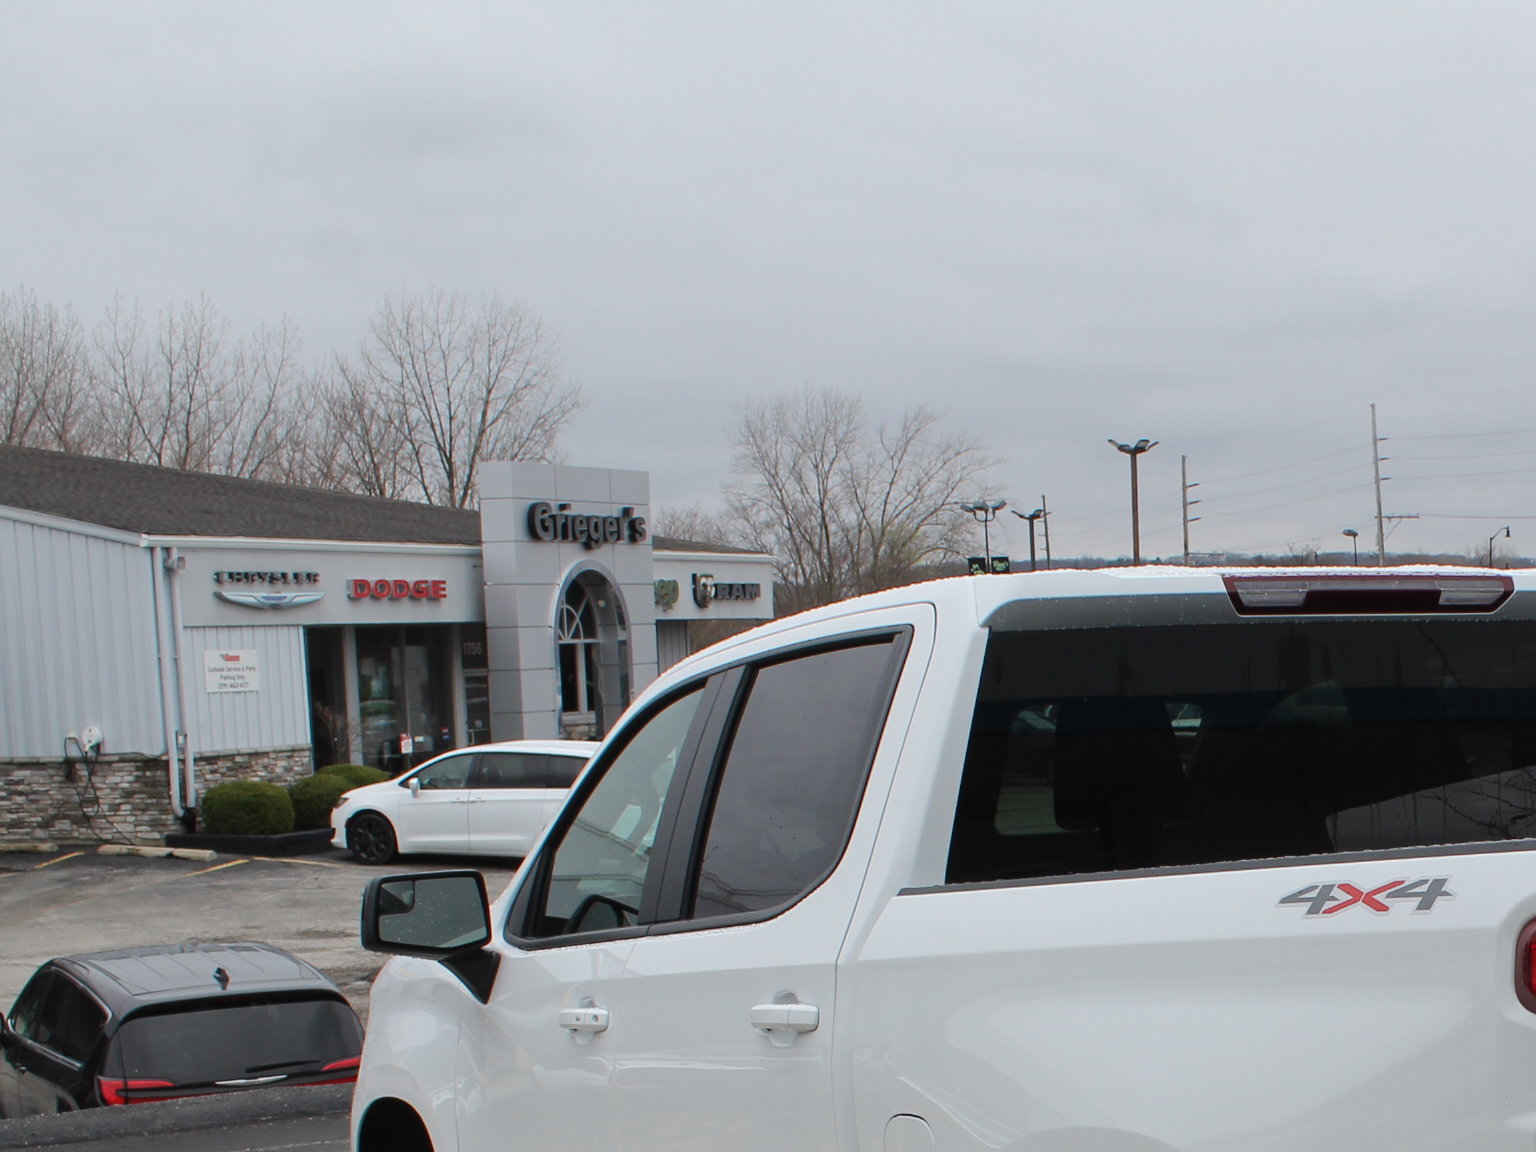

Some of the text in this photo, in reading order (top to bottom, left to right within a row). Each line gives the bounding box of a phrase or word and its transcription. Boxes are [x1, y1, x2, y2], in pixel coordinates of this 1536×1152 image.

[529, 502, 648, 550] Grieger's
[213, 571, 321, 585] CHRYSLER
[350, 579, 448, 601] DODGE
[714, 583, 761, 600] RAM
